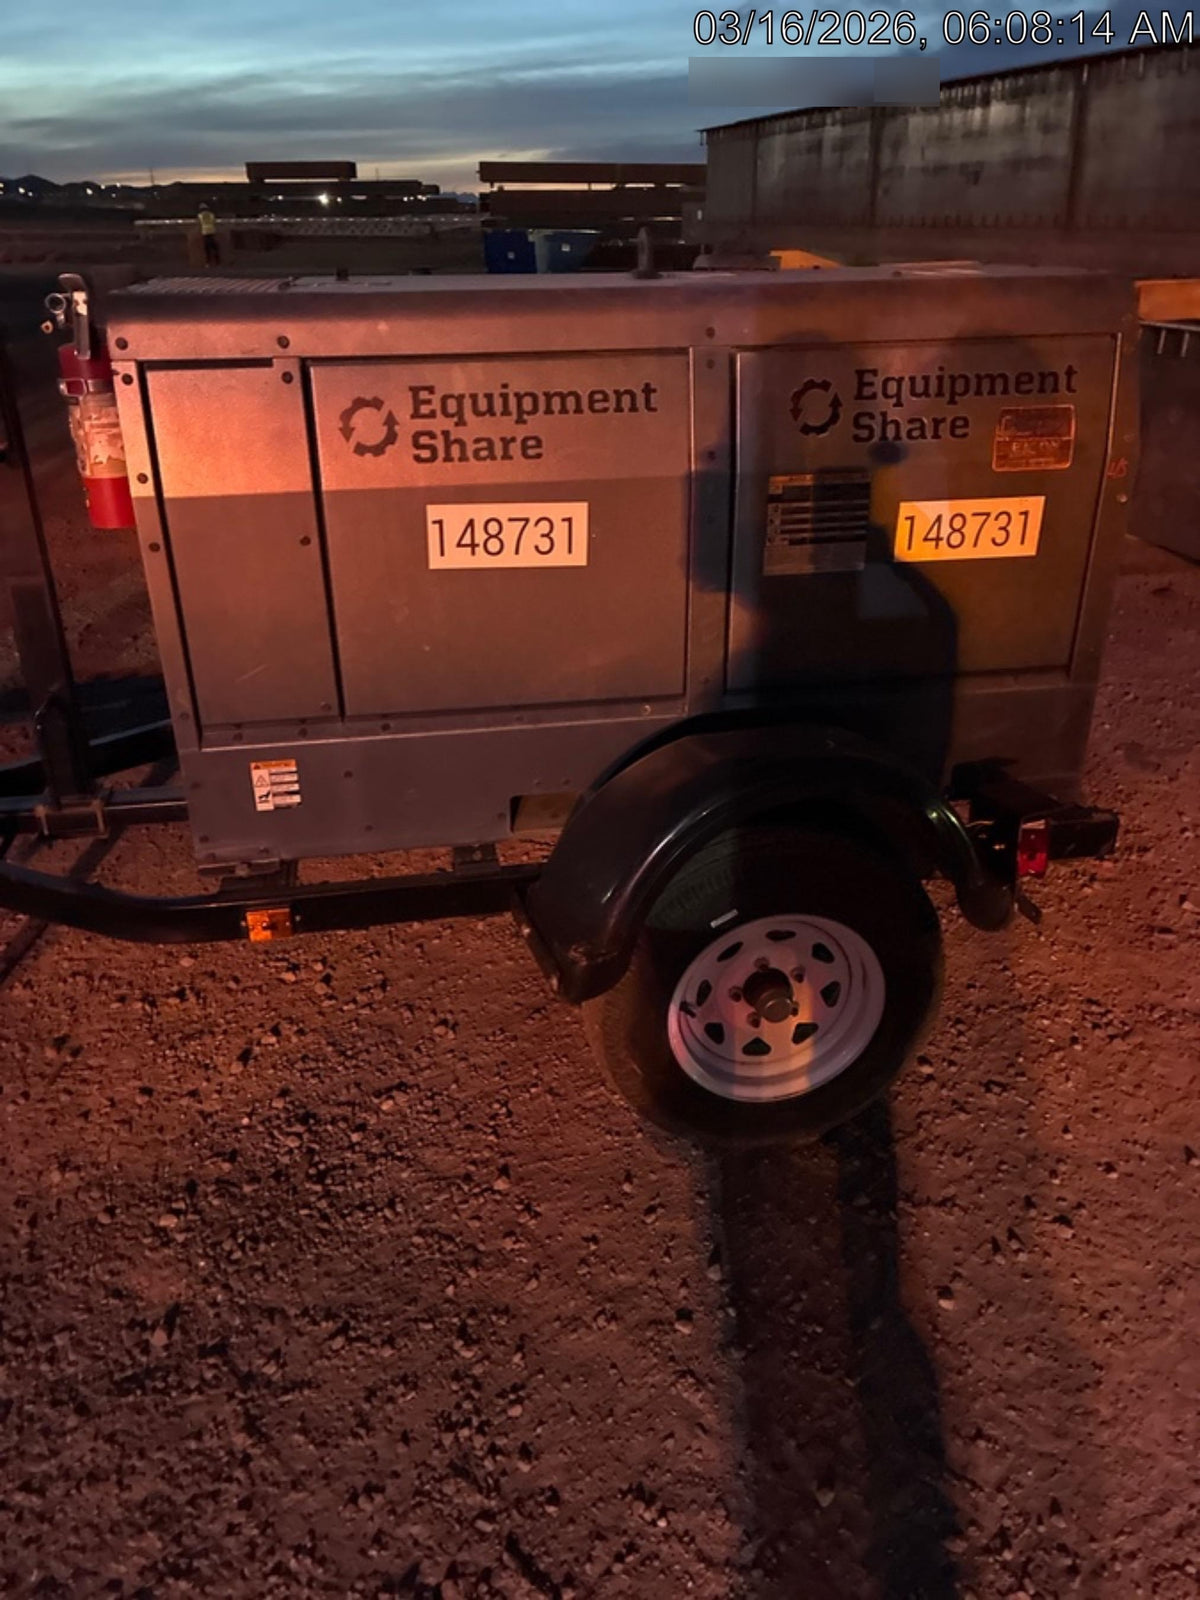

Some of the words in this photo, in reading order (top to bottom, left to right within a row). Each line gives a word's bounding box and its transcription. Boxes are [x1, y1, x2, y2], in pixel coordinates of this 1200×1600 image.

[408, 382, 658, 427] Equipment
[854, 364, 1078, 407] Equipment
[411, 428, 544, 464] Share
[852, 411, 970, 444] Share
[431, 516, 575, 557] 148731
[904, 510, 1031, 551] 148731
